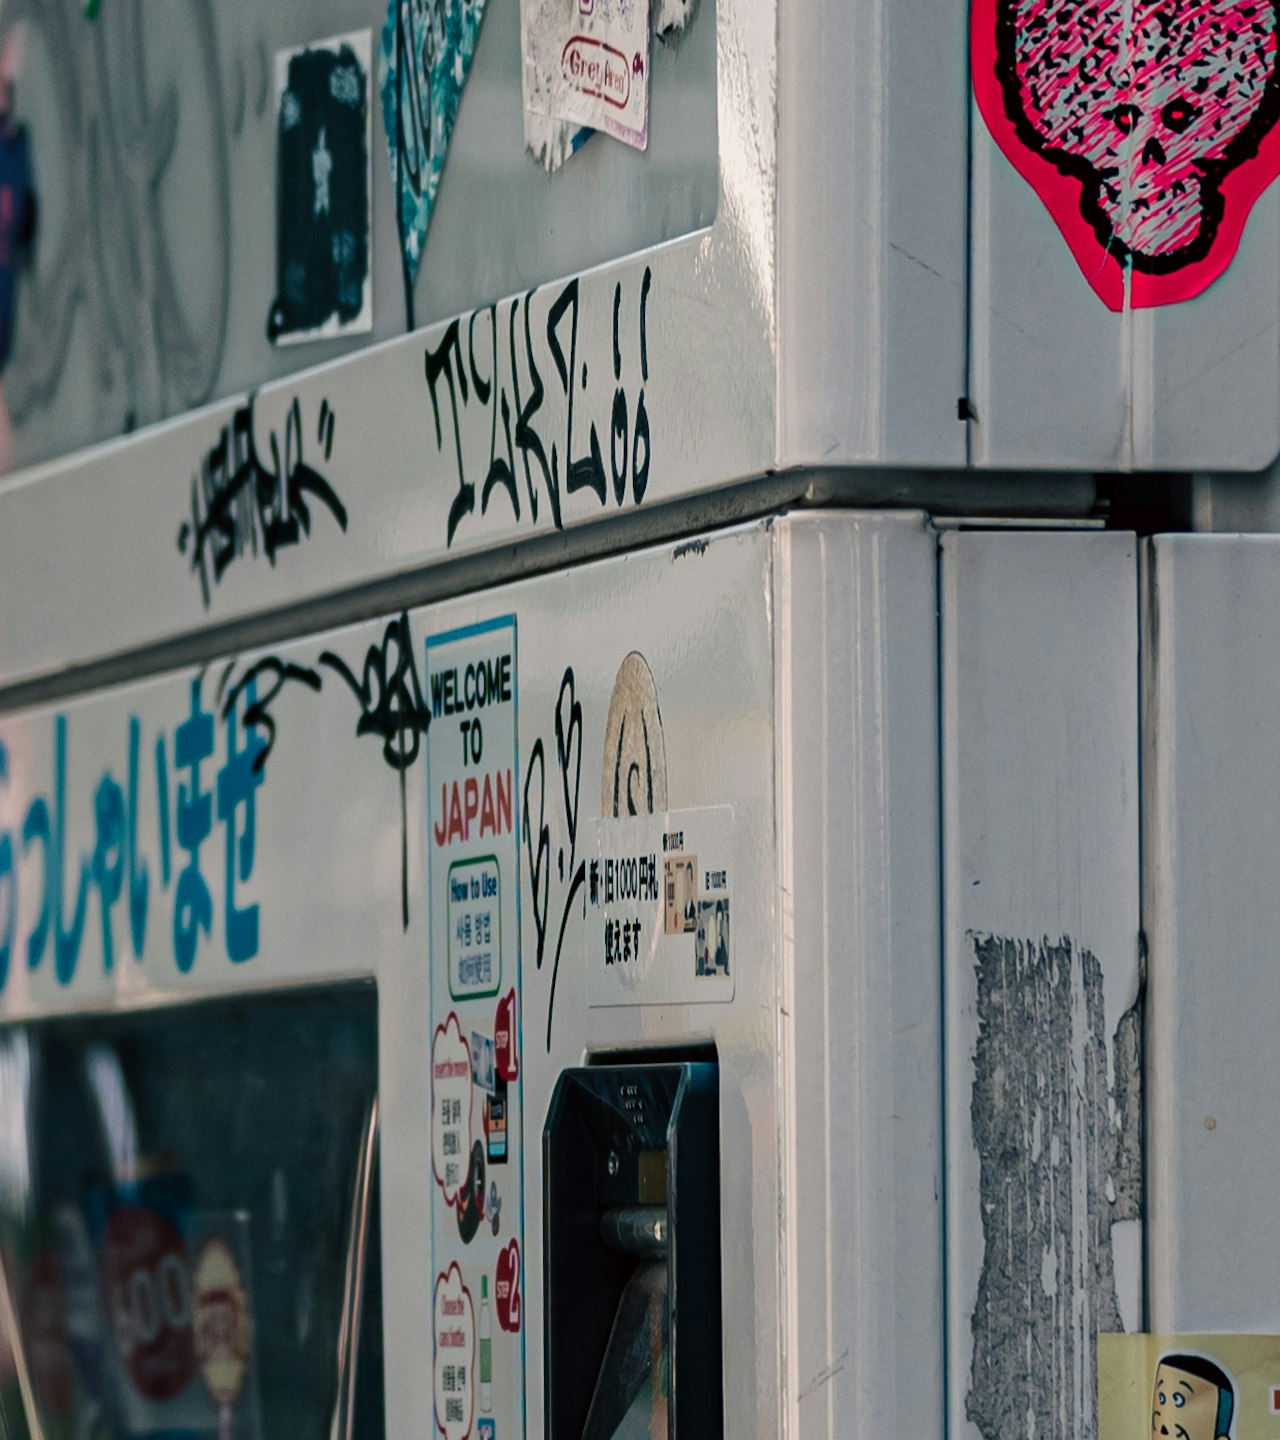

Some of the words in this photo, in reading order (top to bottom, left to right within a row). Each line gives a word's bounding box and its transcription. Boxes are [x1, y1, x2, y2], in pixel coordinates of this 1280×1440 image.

[431, 653, 512, 718] WELCOME
[460, 717, 483, 768] TO
[433, 768, 513, 848] JAPAN
[450, 877, 468, 903] How
[469, 875, 480, 900] to
[481, 872, 498, 898] Use
[604, 916, 642, 966] 使えます
[509, 1246, 519, 1324] 2
